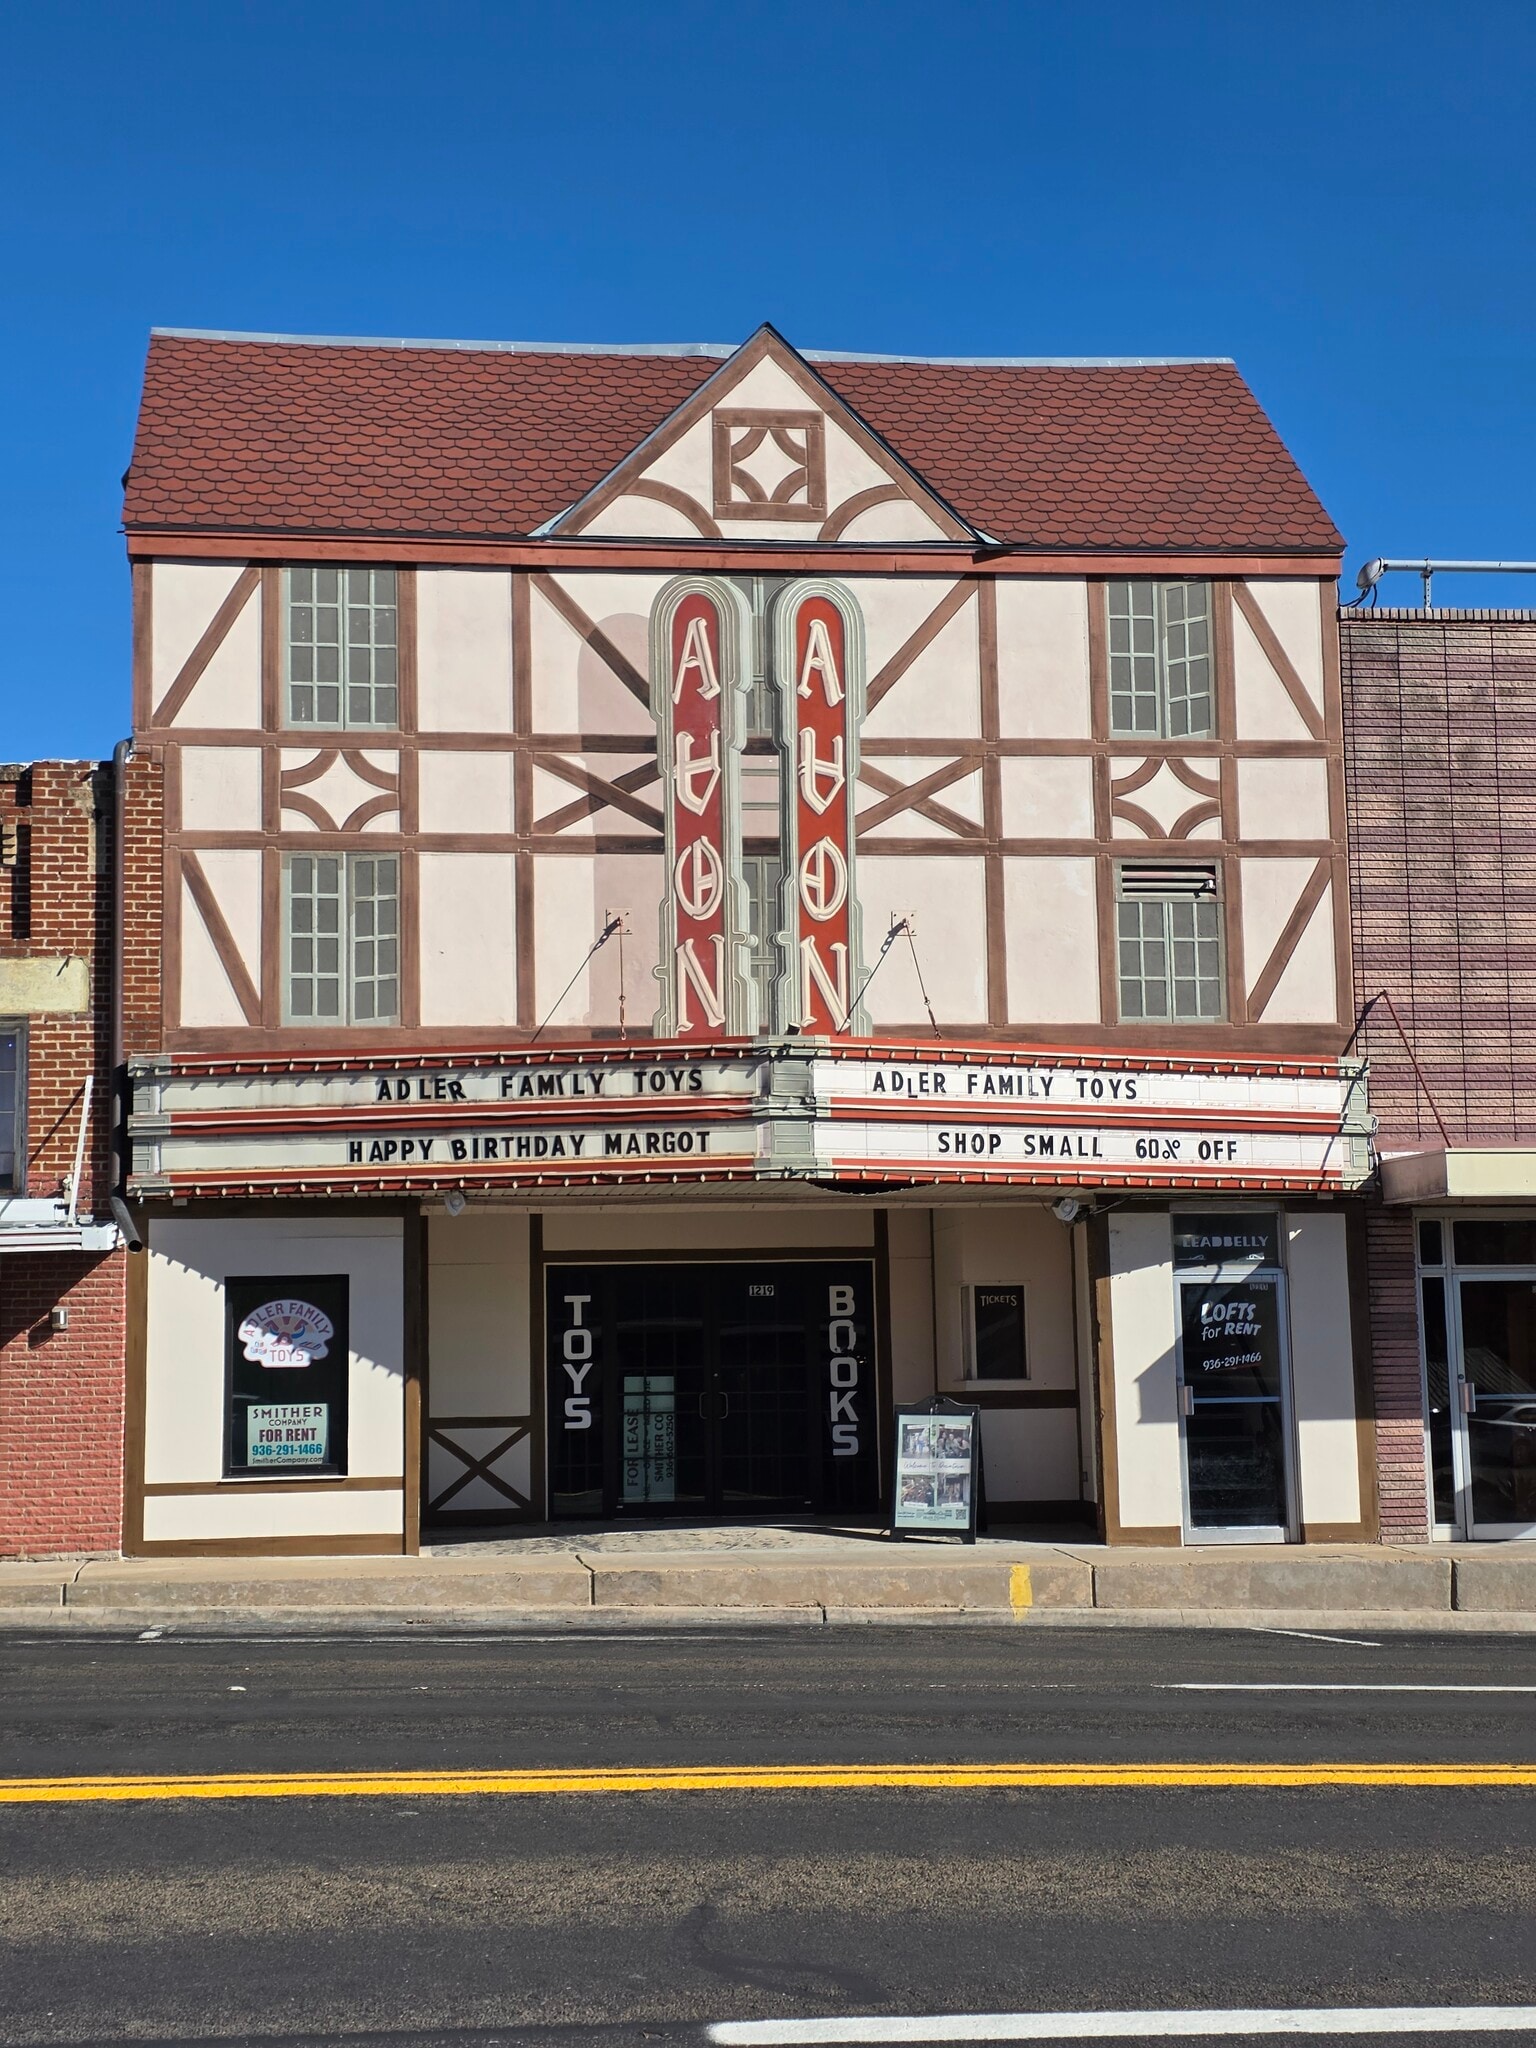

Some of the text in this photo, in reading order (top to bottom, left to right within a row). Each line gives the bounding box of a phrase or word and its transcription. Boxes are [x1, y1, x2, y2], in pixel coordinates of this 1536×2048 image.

[377, 1069, 703, 1101] ADLER FAMILY TOYS
[873, 1071, 1137, 1100] ADLER FAMILY TOYS
[350, 1131, 710, 1163] HAPPY BIRTHDAY MARGOT
[937, 1132, 1002, 1155] SHOP
[1024, 1134, 1104, 1158] SMALL
[1198, 1140, 1238, 1162] OFF
[1182, 1236, 1268, 1248] LEADBELLY
[750, 1286, 774, 1296] 1219
[980, 1295, 1017, 1307] TICKETS
[243, 1303, 330, 1337] ADLER FAMILY
[1201, 1302, 1257, 1325] LOFTS
[1201, 1322, 1262, 1341] for RENT
[270, 1348, 304, 1362] TOYS
[562, 1295, 593, 1429] TOYS
[1203, 1352, 1262, 1371] 936-291-1466
[828, 1285, 860, 1456] BOOKS
[252, 1407, 323, 1419] SMITHER
[268, 1419, 308, 1427] COMPANY
[259, 1428, 317, 1443] FOR RENT
[252, 1444, 323, 1456] 936-291-1466
[627, 1408, 638, 1487] FOR LEASE
[252, 1457, 324, 1465] SmitherCompany.com
[654, 1434, 664, 1482] SMITHER
